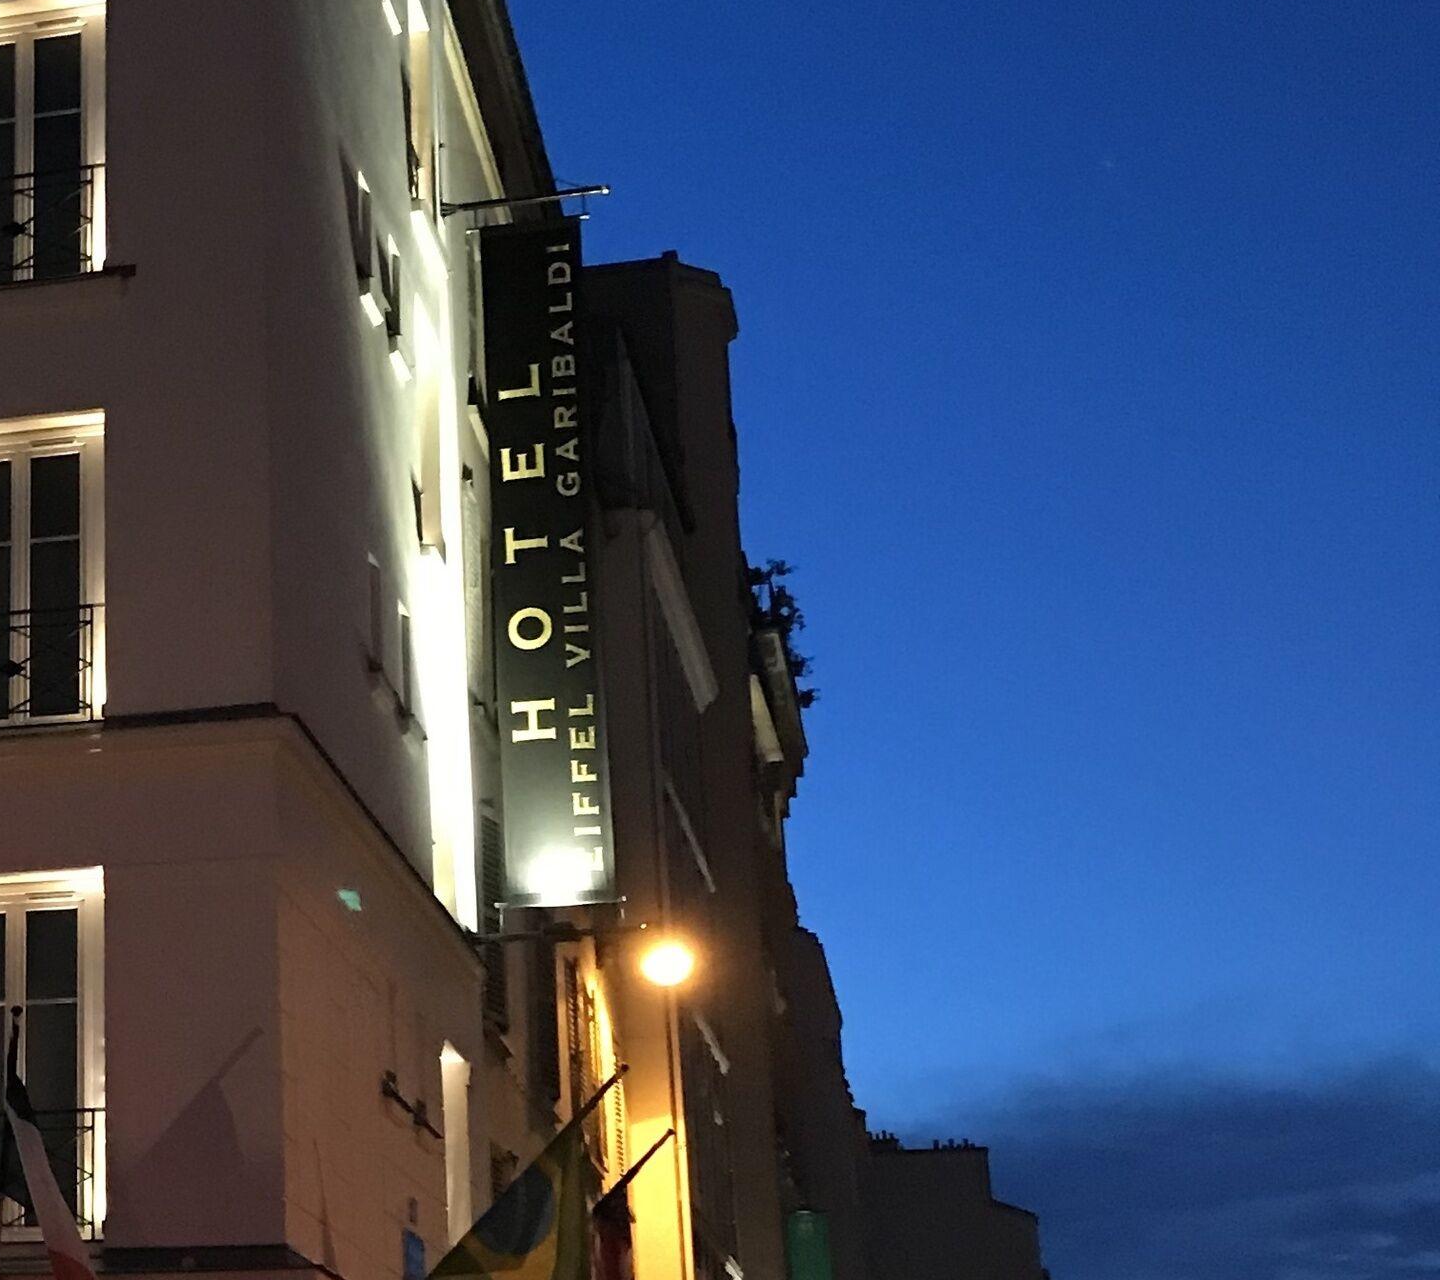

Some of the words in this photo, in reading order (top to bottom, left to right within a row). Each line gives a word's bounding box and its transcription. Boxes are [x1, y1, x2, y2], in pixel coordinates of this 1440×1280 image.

[547, 241, 582, 497] GARIBALDI
[498, 362, 558, 744] HOTEL
[558, 528, 591, 668] VILLA
